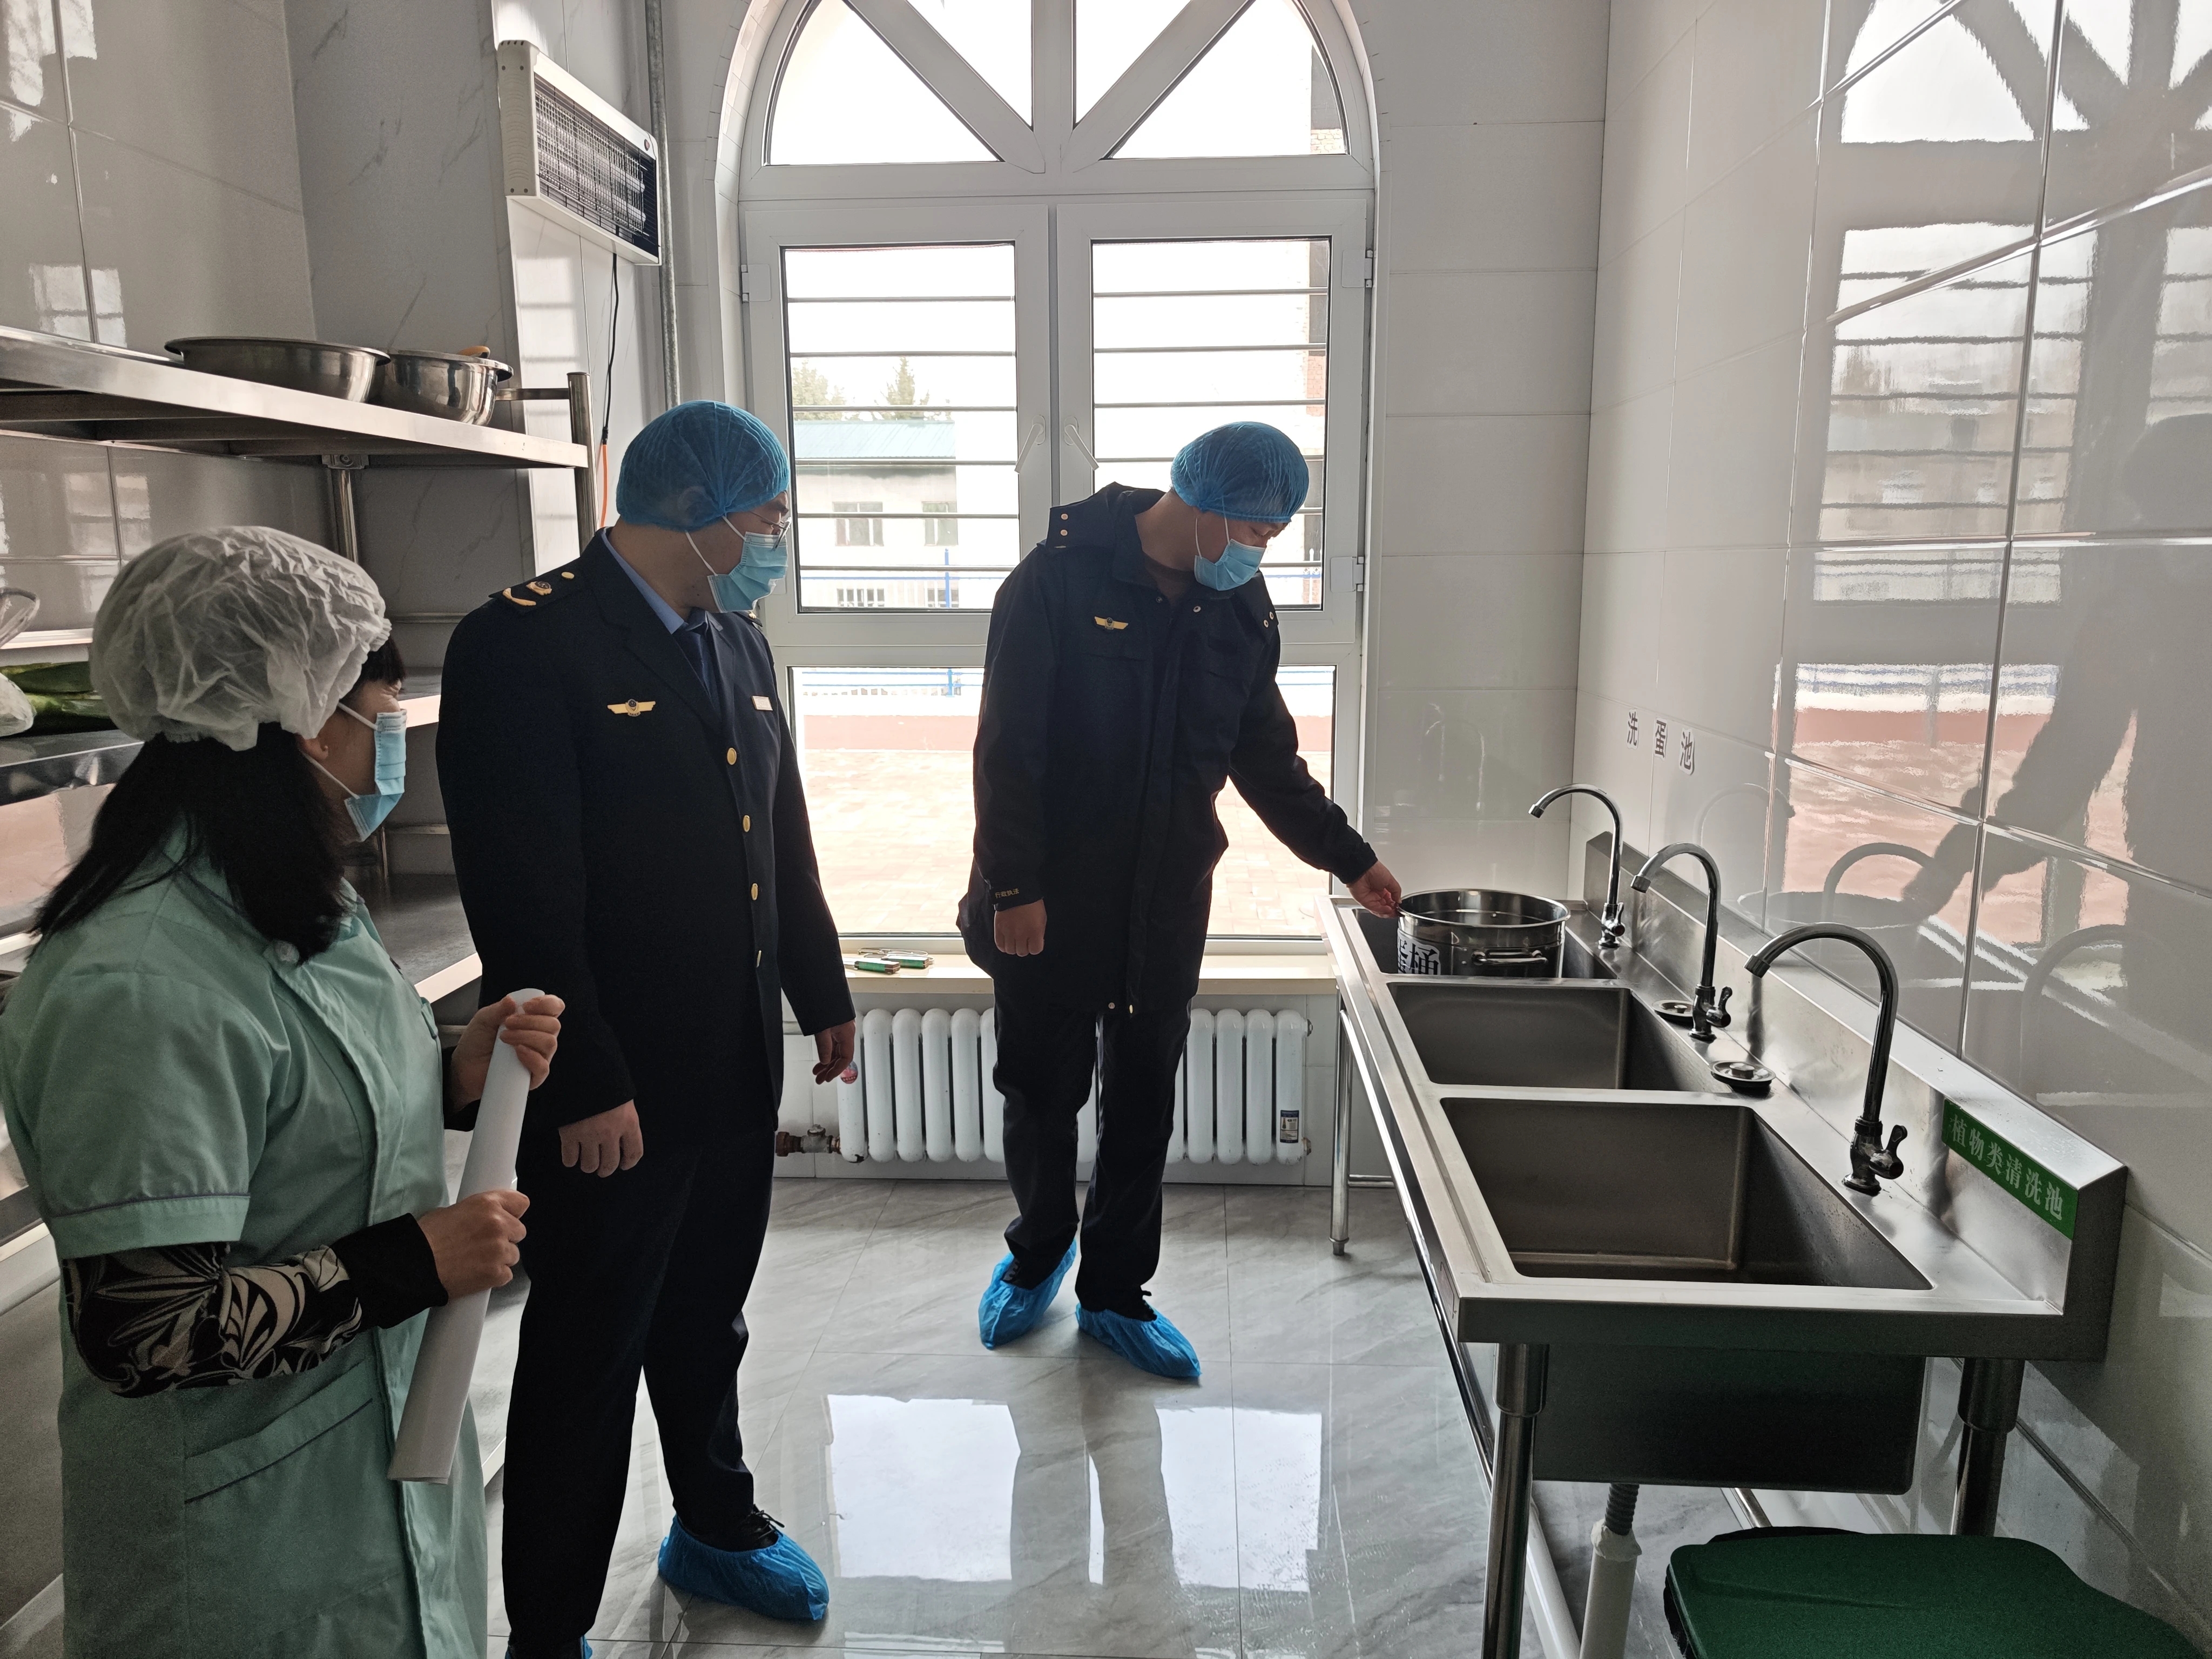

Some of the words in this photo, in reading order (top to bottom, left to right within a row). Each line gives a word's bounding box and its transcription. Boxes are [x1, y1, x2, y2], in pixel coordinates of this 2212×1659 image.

[1627, 711, 1693, 770] 洗蛋池
[1951, 1114, 2063, 1220] 植物类清洗池
